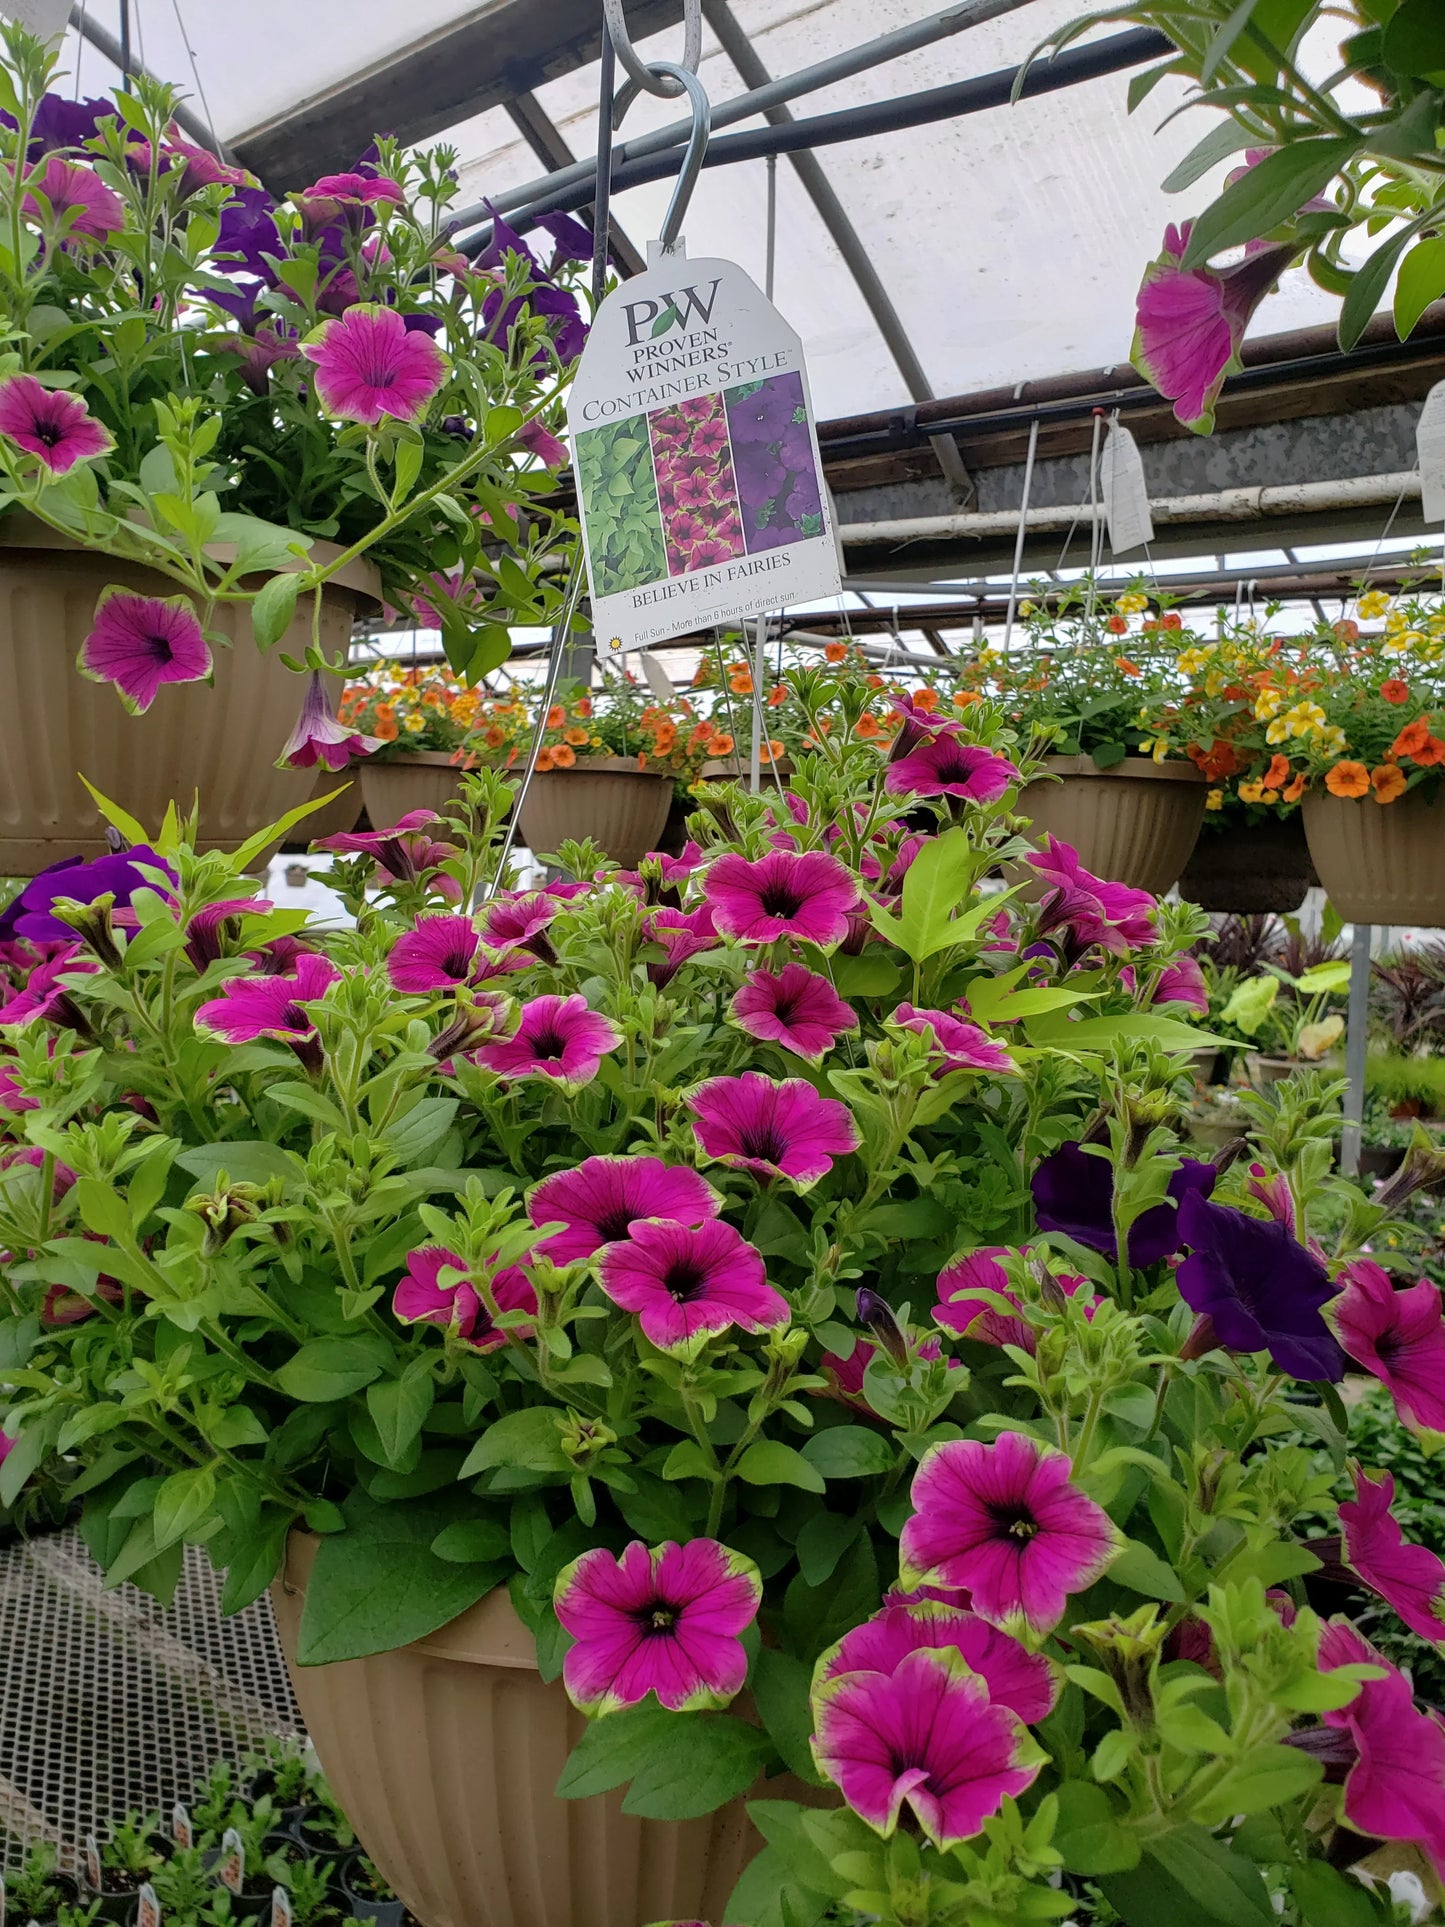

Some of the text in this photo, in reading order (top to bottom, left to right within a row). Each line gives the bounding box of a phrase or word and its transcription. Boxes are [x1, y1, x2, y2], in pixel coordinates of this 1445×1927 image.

[633, 327, 718, 364] PROVEN
[582, 373, 711, 421] CONTAINER
[632, 552, 791, 609] BELIEVE IN FAIRIES
[634, 631, 649, 643] Full
[650, 627, 665, 638] Sun
[671, 619, 693, 632] More
[695, 612, 712, 625] than
[713, 611, 720, 620] 6
[720, 605, 744, 618] hours
[745, 600, 753, 612] of
[755, 595, 778, 609] direct
[780, 591, 795, 602] sun
